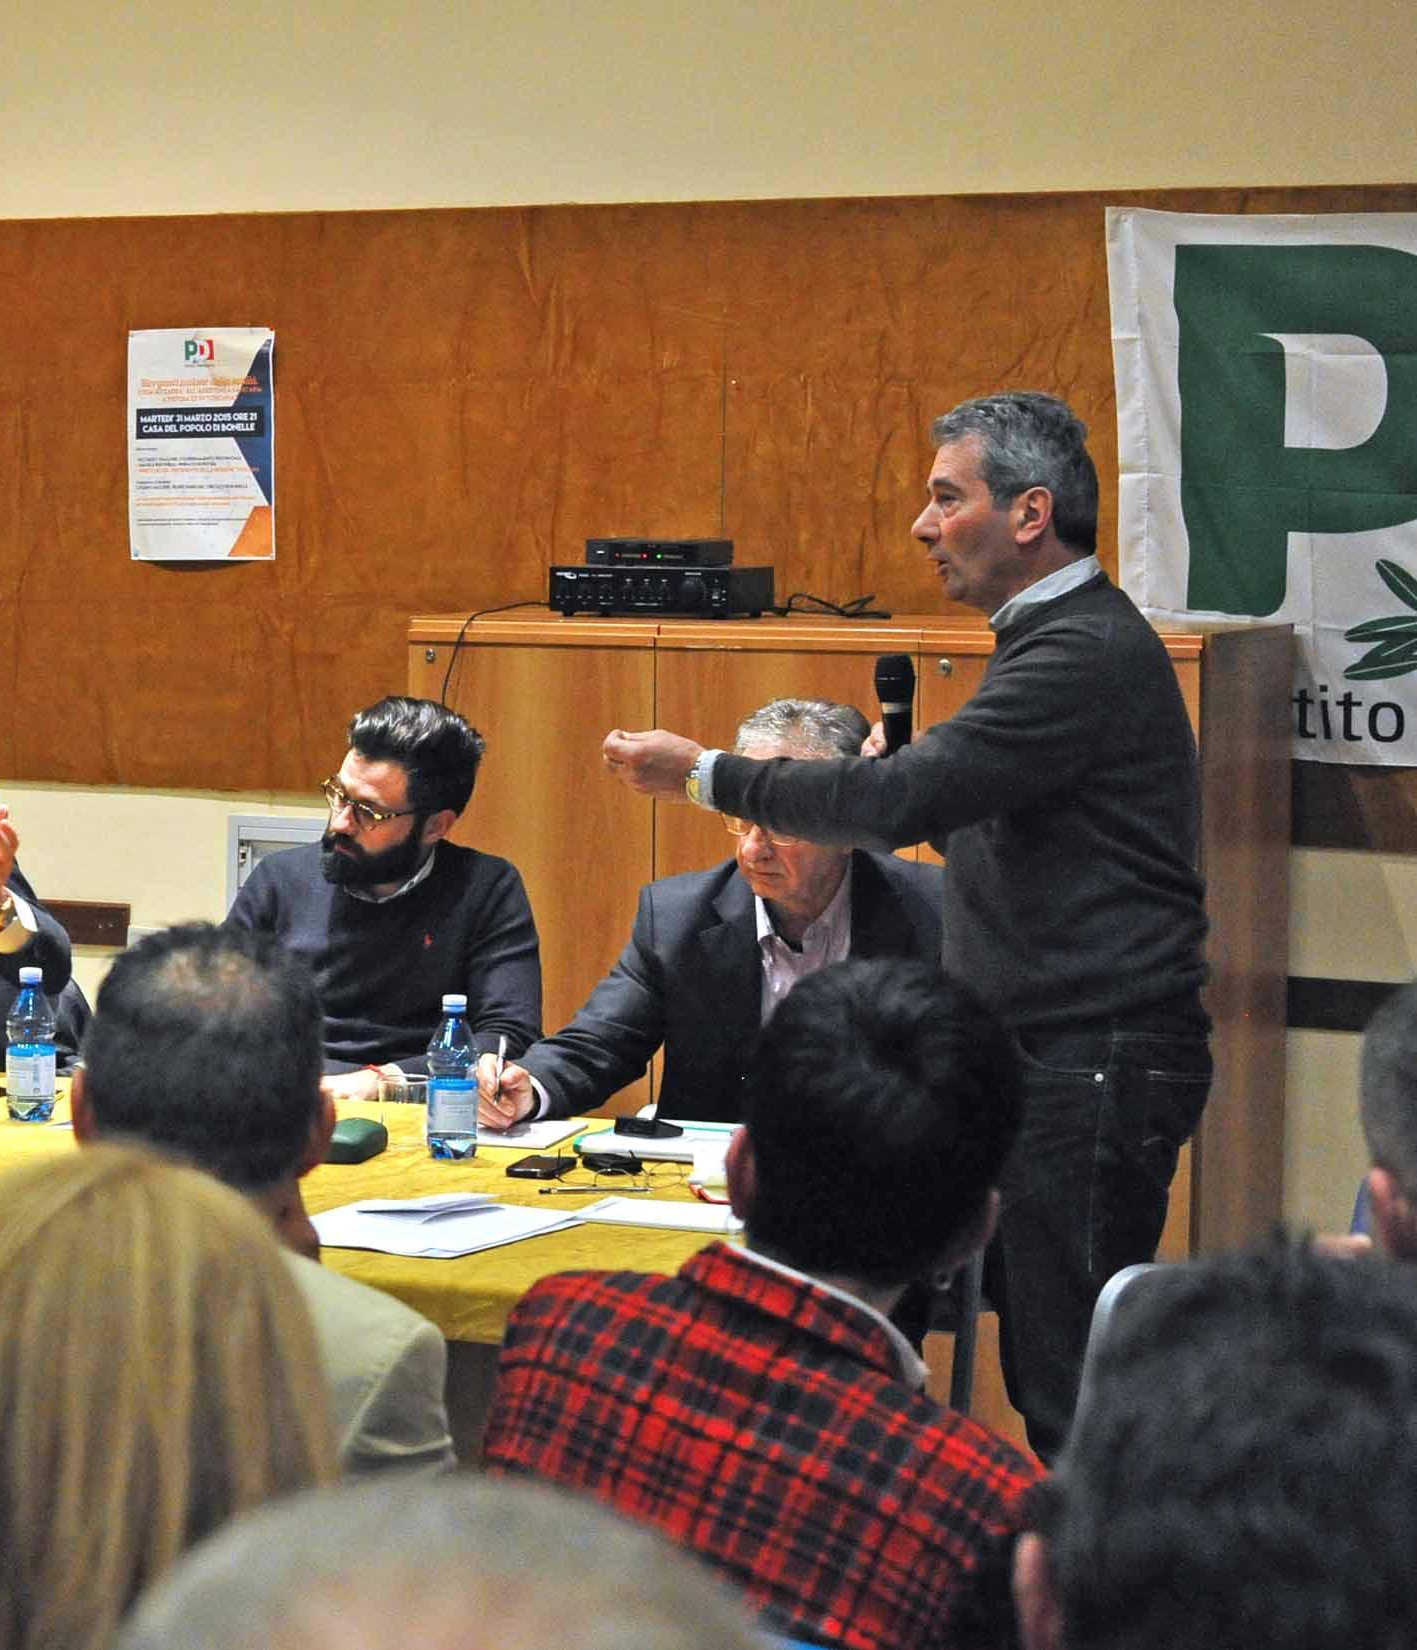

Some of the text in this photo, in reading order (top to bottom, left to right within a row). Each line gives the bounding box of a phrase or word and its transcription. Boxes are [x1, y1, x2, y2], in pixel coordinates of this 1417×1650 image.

[142, 422, 255, 433] CASA DEL POPOLO DI BONELLE
[184, 413, 212, 422] MARZO
[213, 413, 232, 422] 2015
[232, 412, 248, 421] ORE
[249, 412, 257, 421] 21
[1173, 244, 1417, 618] P
[1291, 684, 1405, 743] tito
